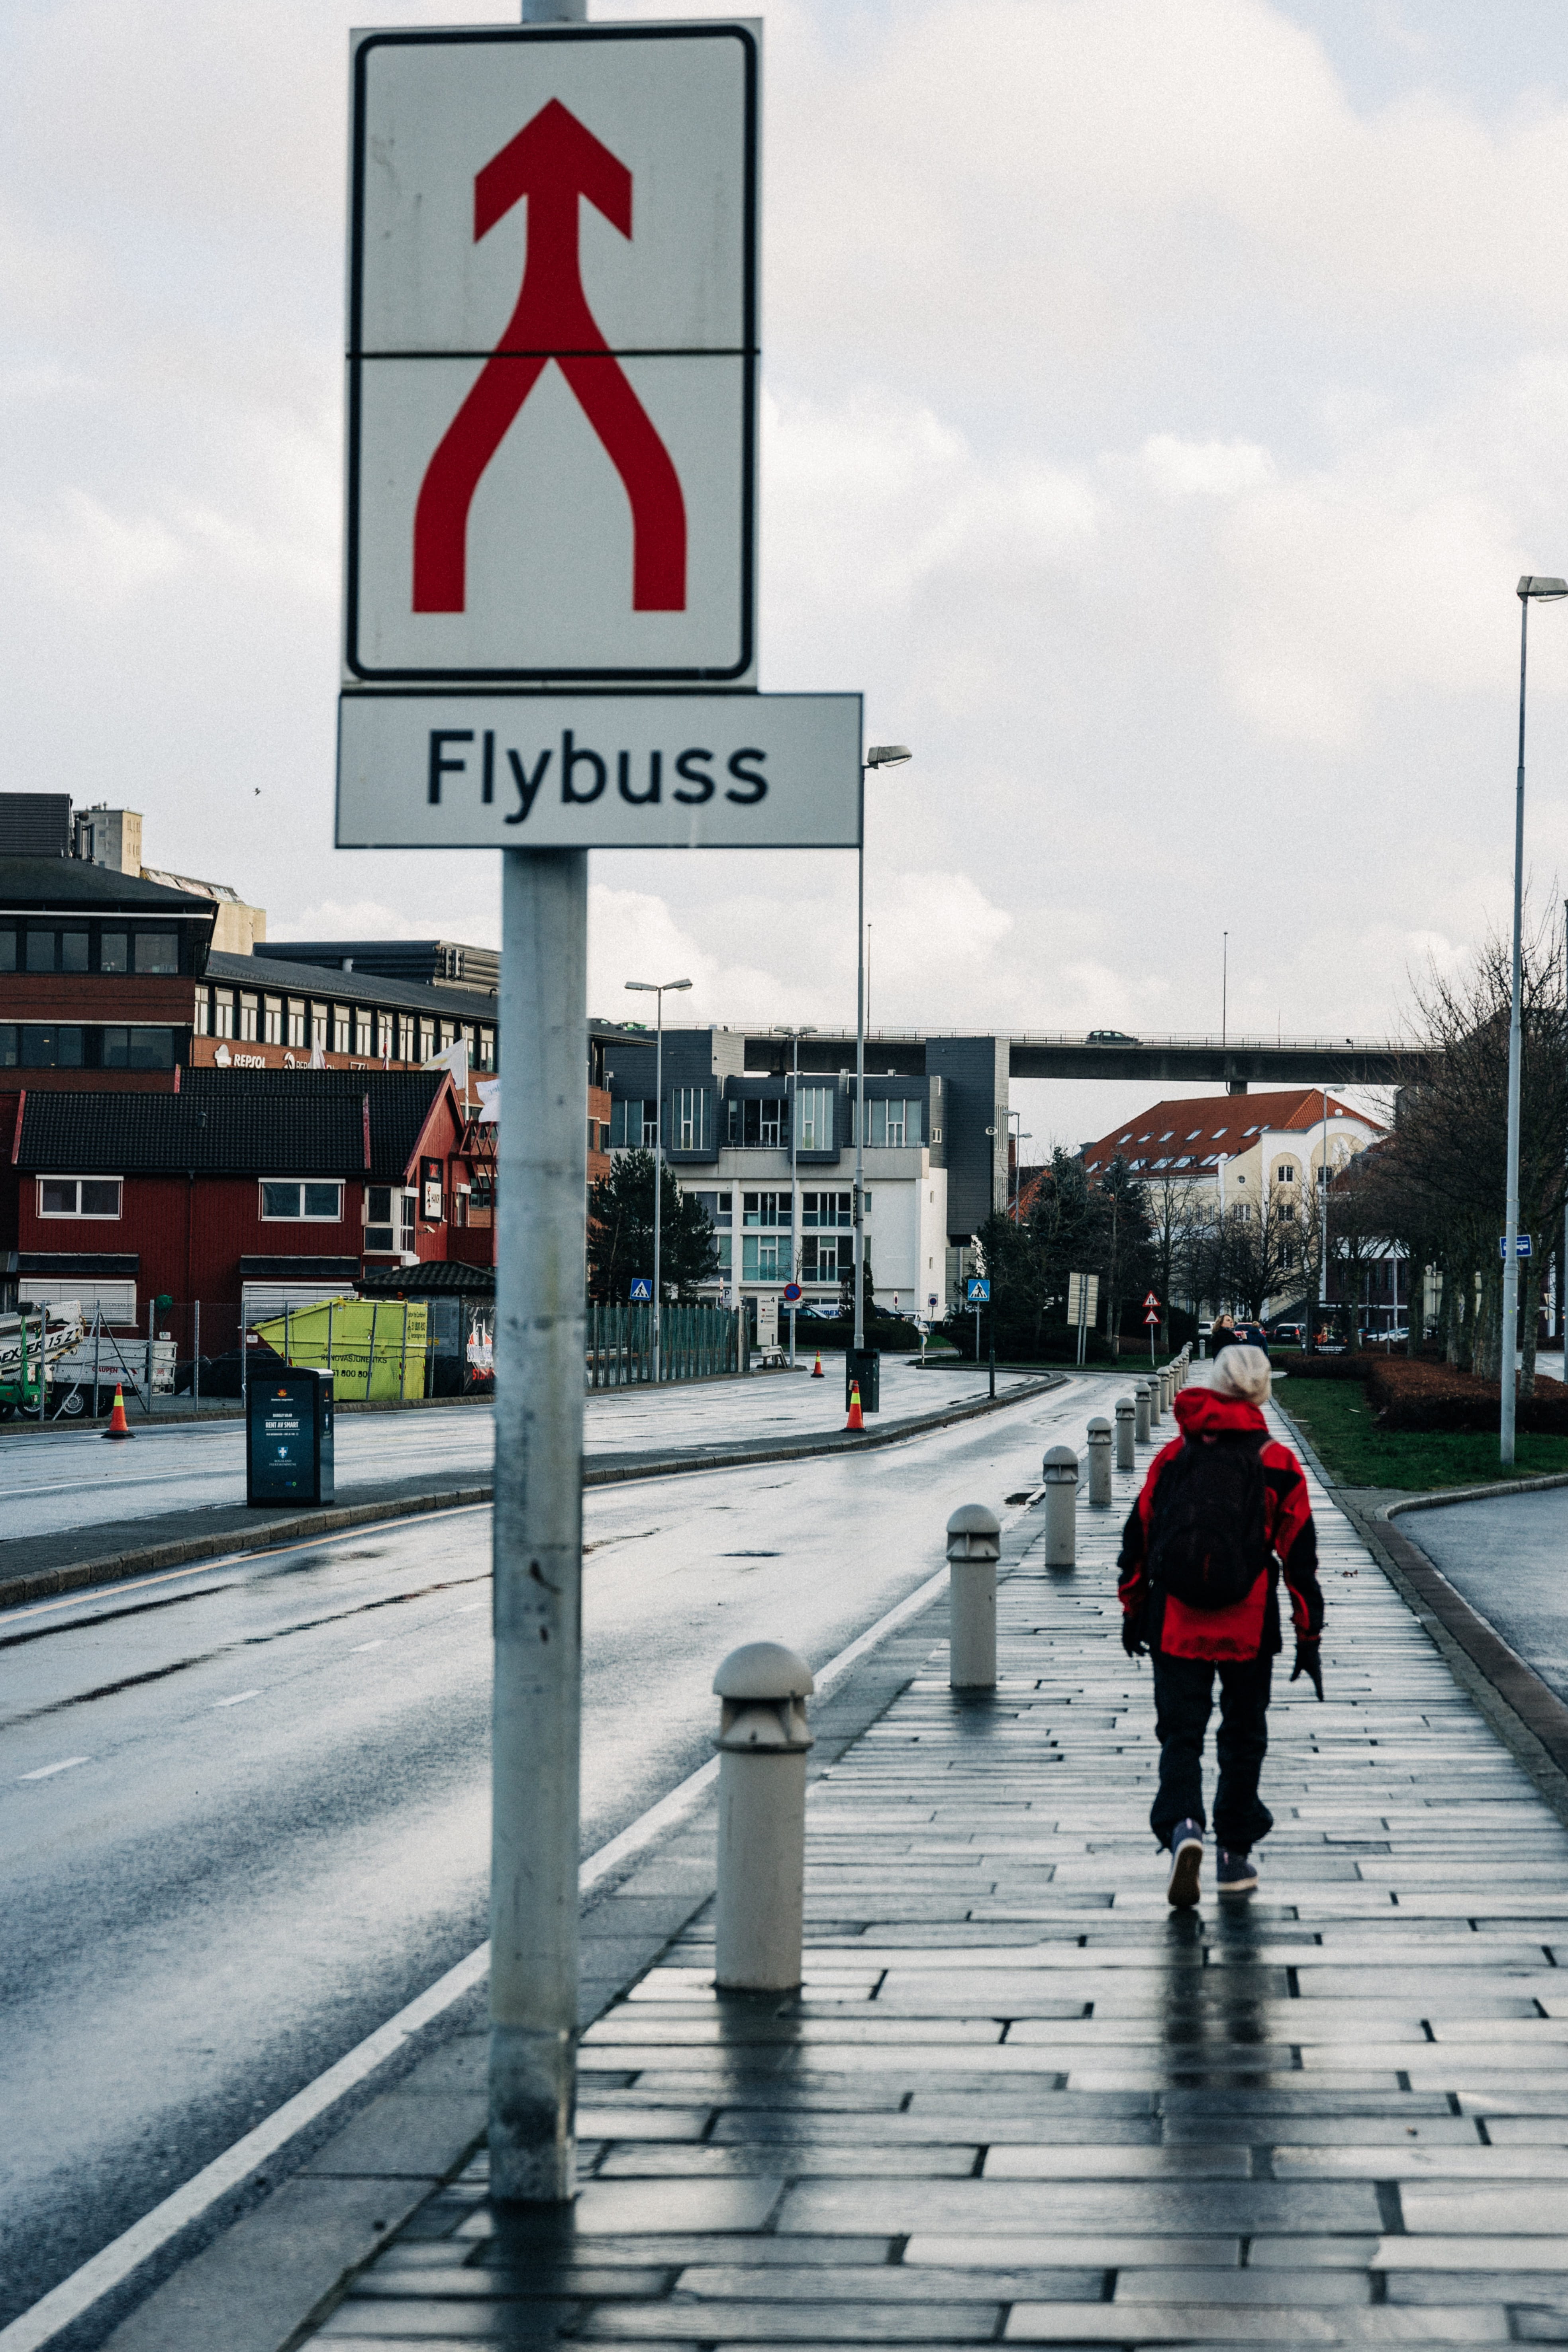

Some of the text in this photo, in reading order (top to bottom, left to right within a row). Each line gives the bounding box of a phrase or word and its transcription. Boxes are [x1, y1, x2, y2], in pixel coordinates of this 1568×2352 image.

[427, 729, 770, 825] Flybuss
[233, 1053, 266, 1068] REPSOL
[724, 1290, 729, 1298] P
[48, 1335, 62, 1348] 15
[64, 1330, 74, 1343] Z
